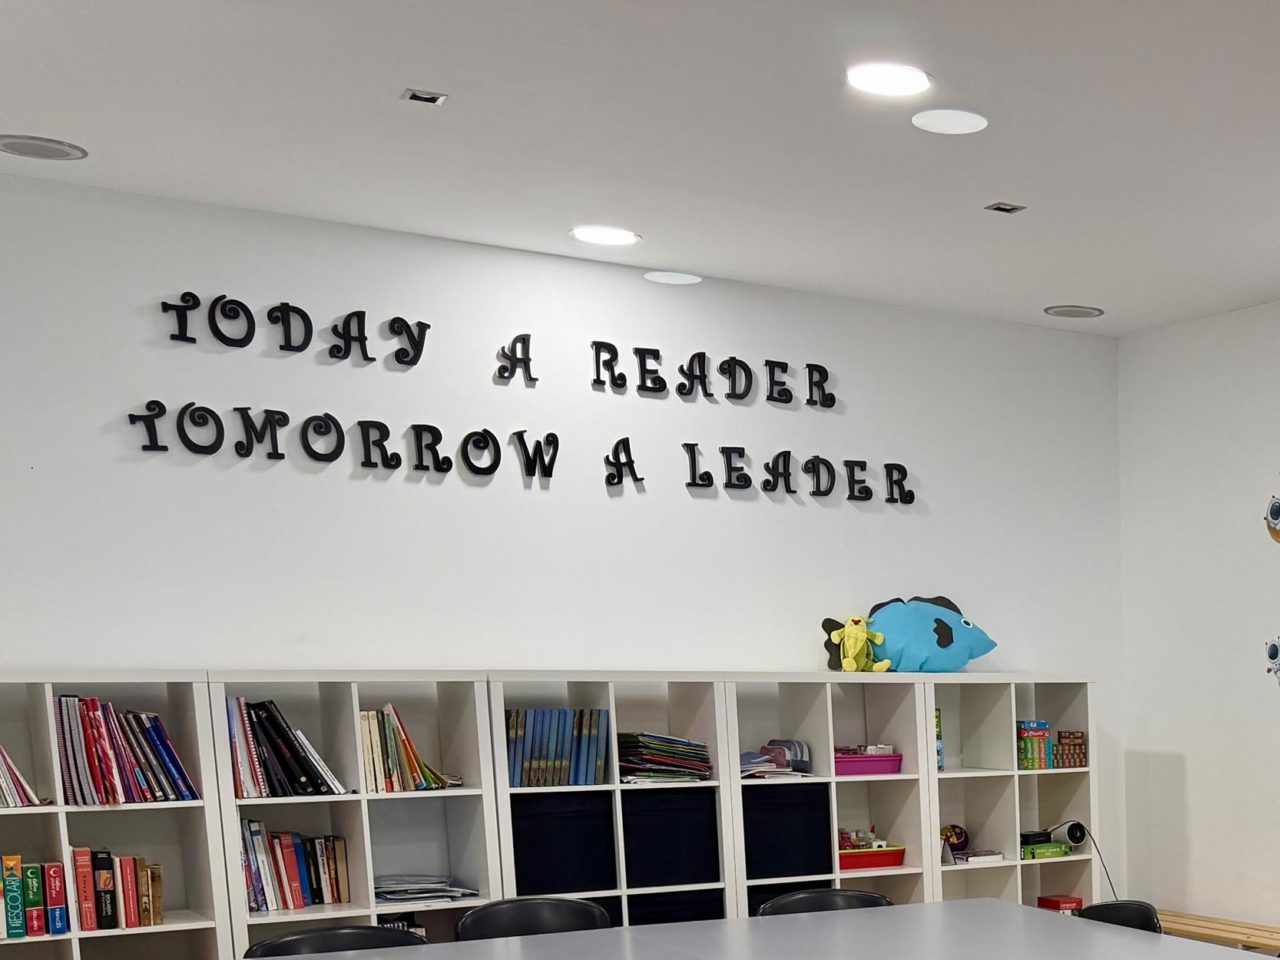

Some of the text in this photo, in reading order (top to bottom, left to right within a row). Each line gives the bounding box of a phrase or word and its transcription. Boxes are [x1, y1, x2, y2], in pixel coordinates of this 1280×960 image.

[161, 291, 836, 409] TODAY A READER
[128, 399, 916, 505] TOMORROW A LEADER
